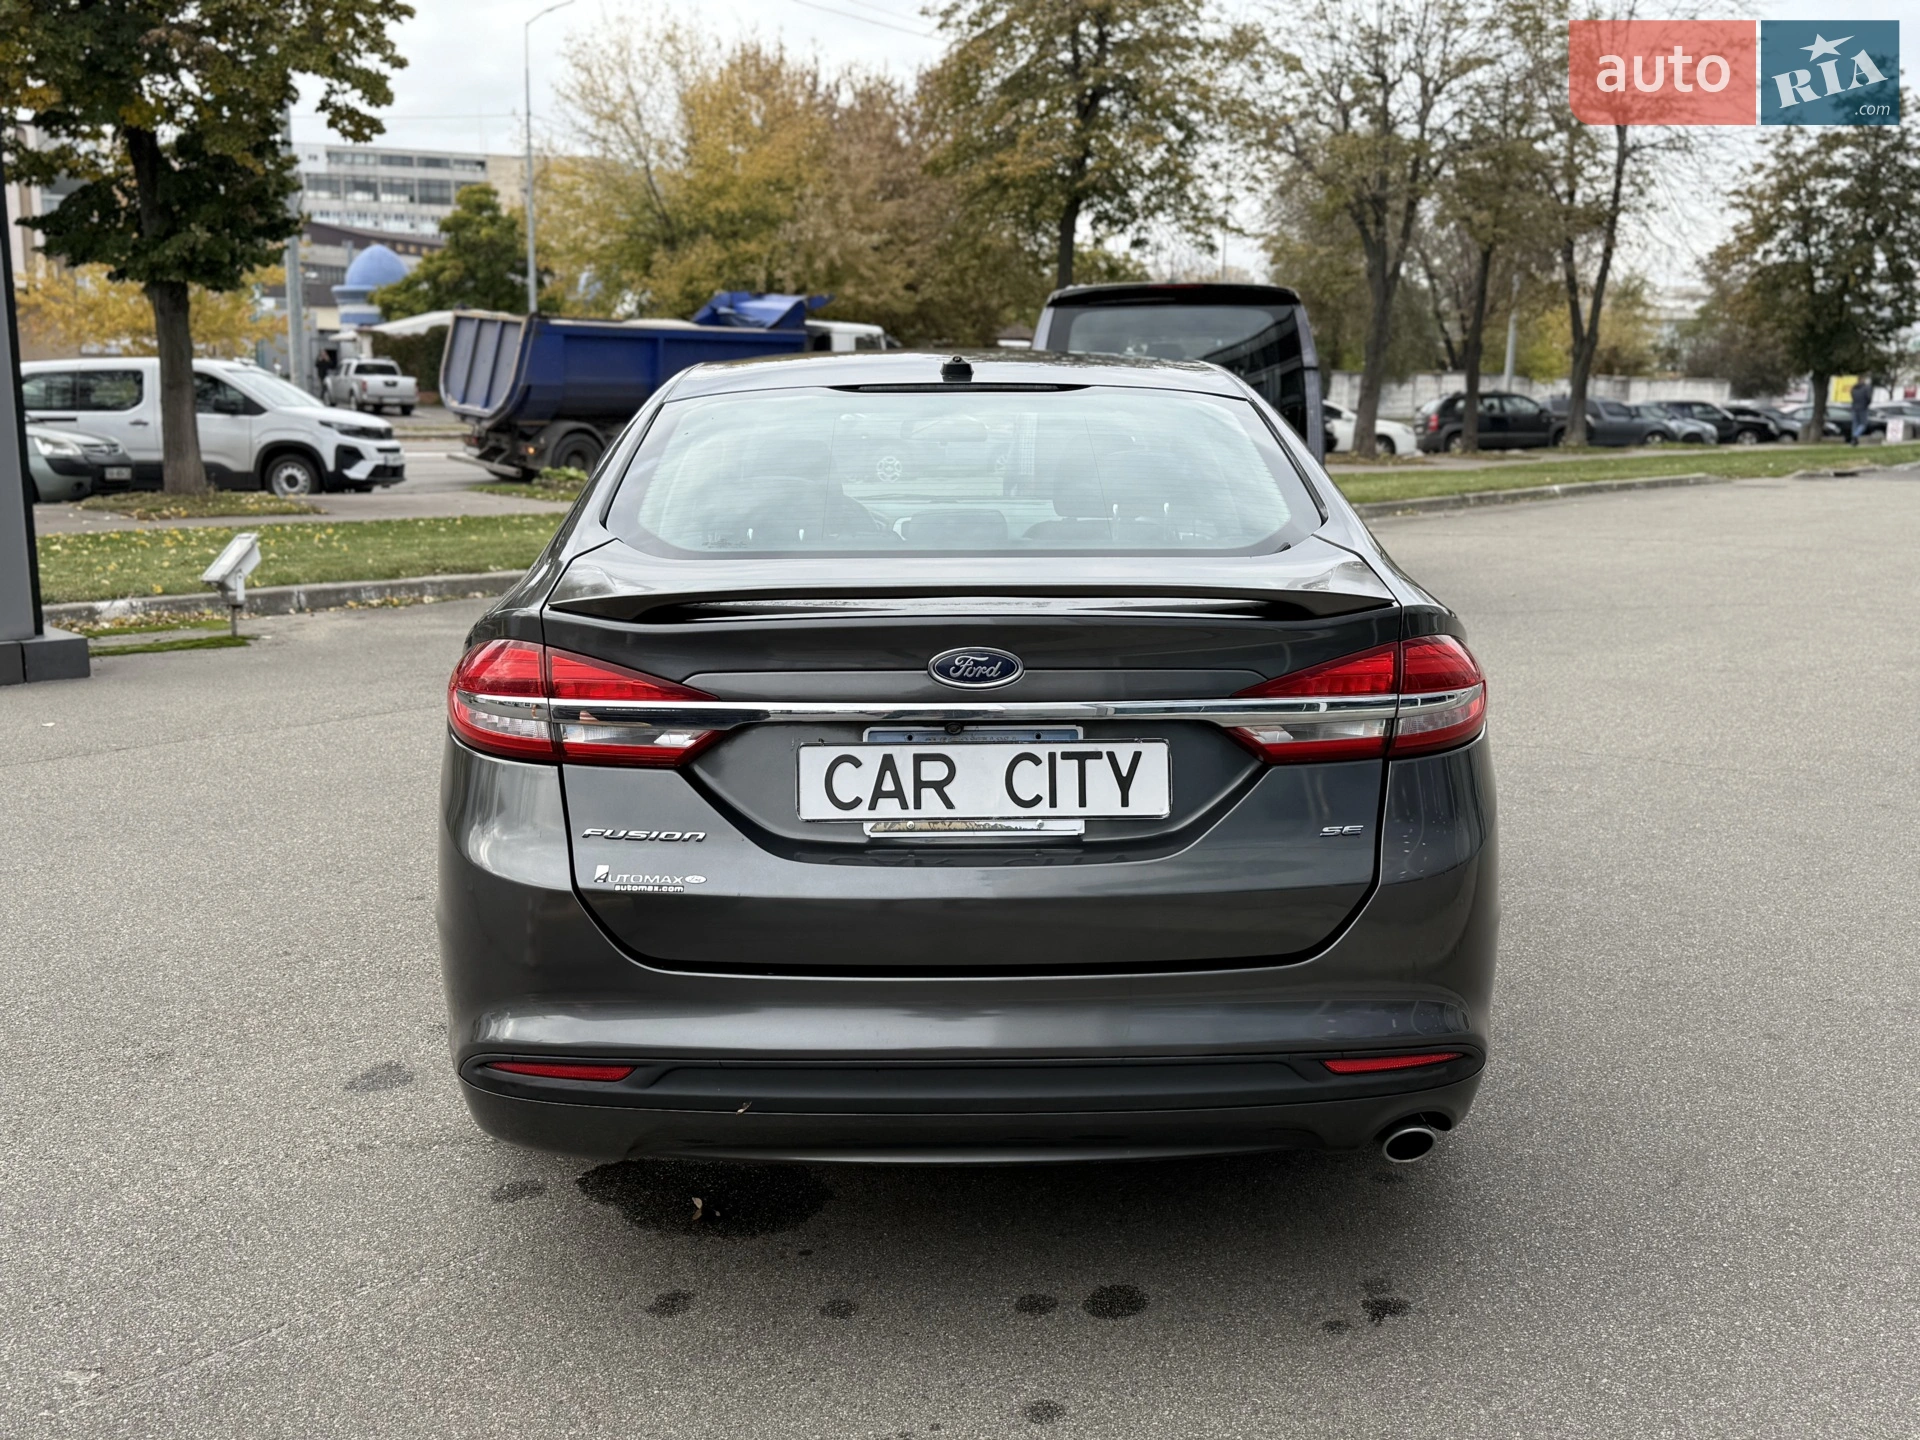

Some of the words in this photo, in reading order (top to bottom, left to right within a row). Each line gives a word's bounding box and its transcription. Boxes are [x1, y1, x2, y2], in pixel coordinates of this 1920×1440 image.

[949, 656, 1003, 679] Ford
[824, 752, 957, 811] CAR
[1004, 750, 1143, 809] CITY
[582, 828, 707, 843] FUSION
[1319, 825, 1364, 837] SE
[594, 865, 684, 884] AUTOMAX
[614, 884, 685, 893] automax.com
